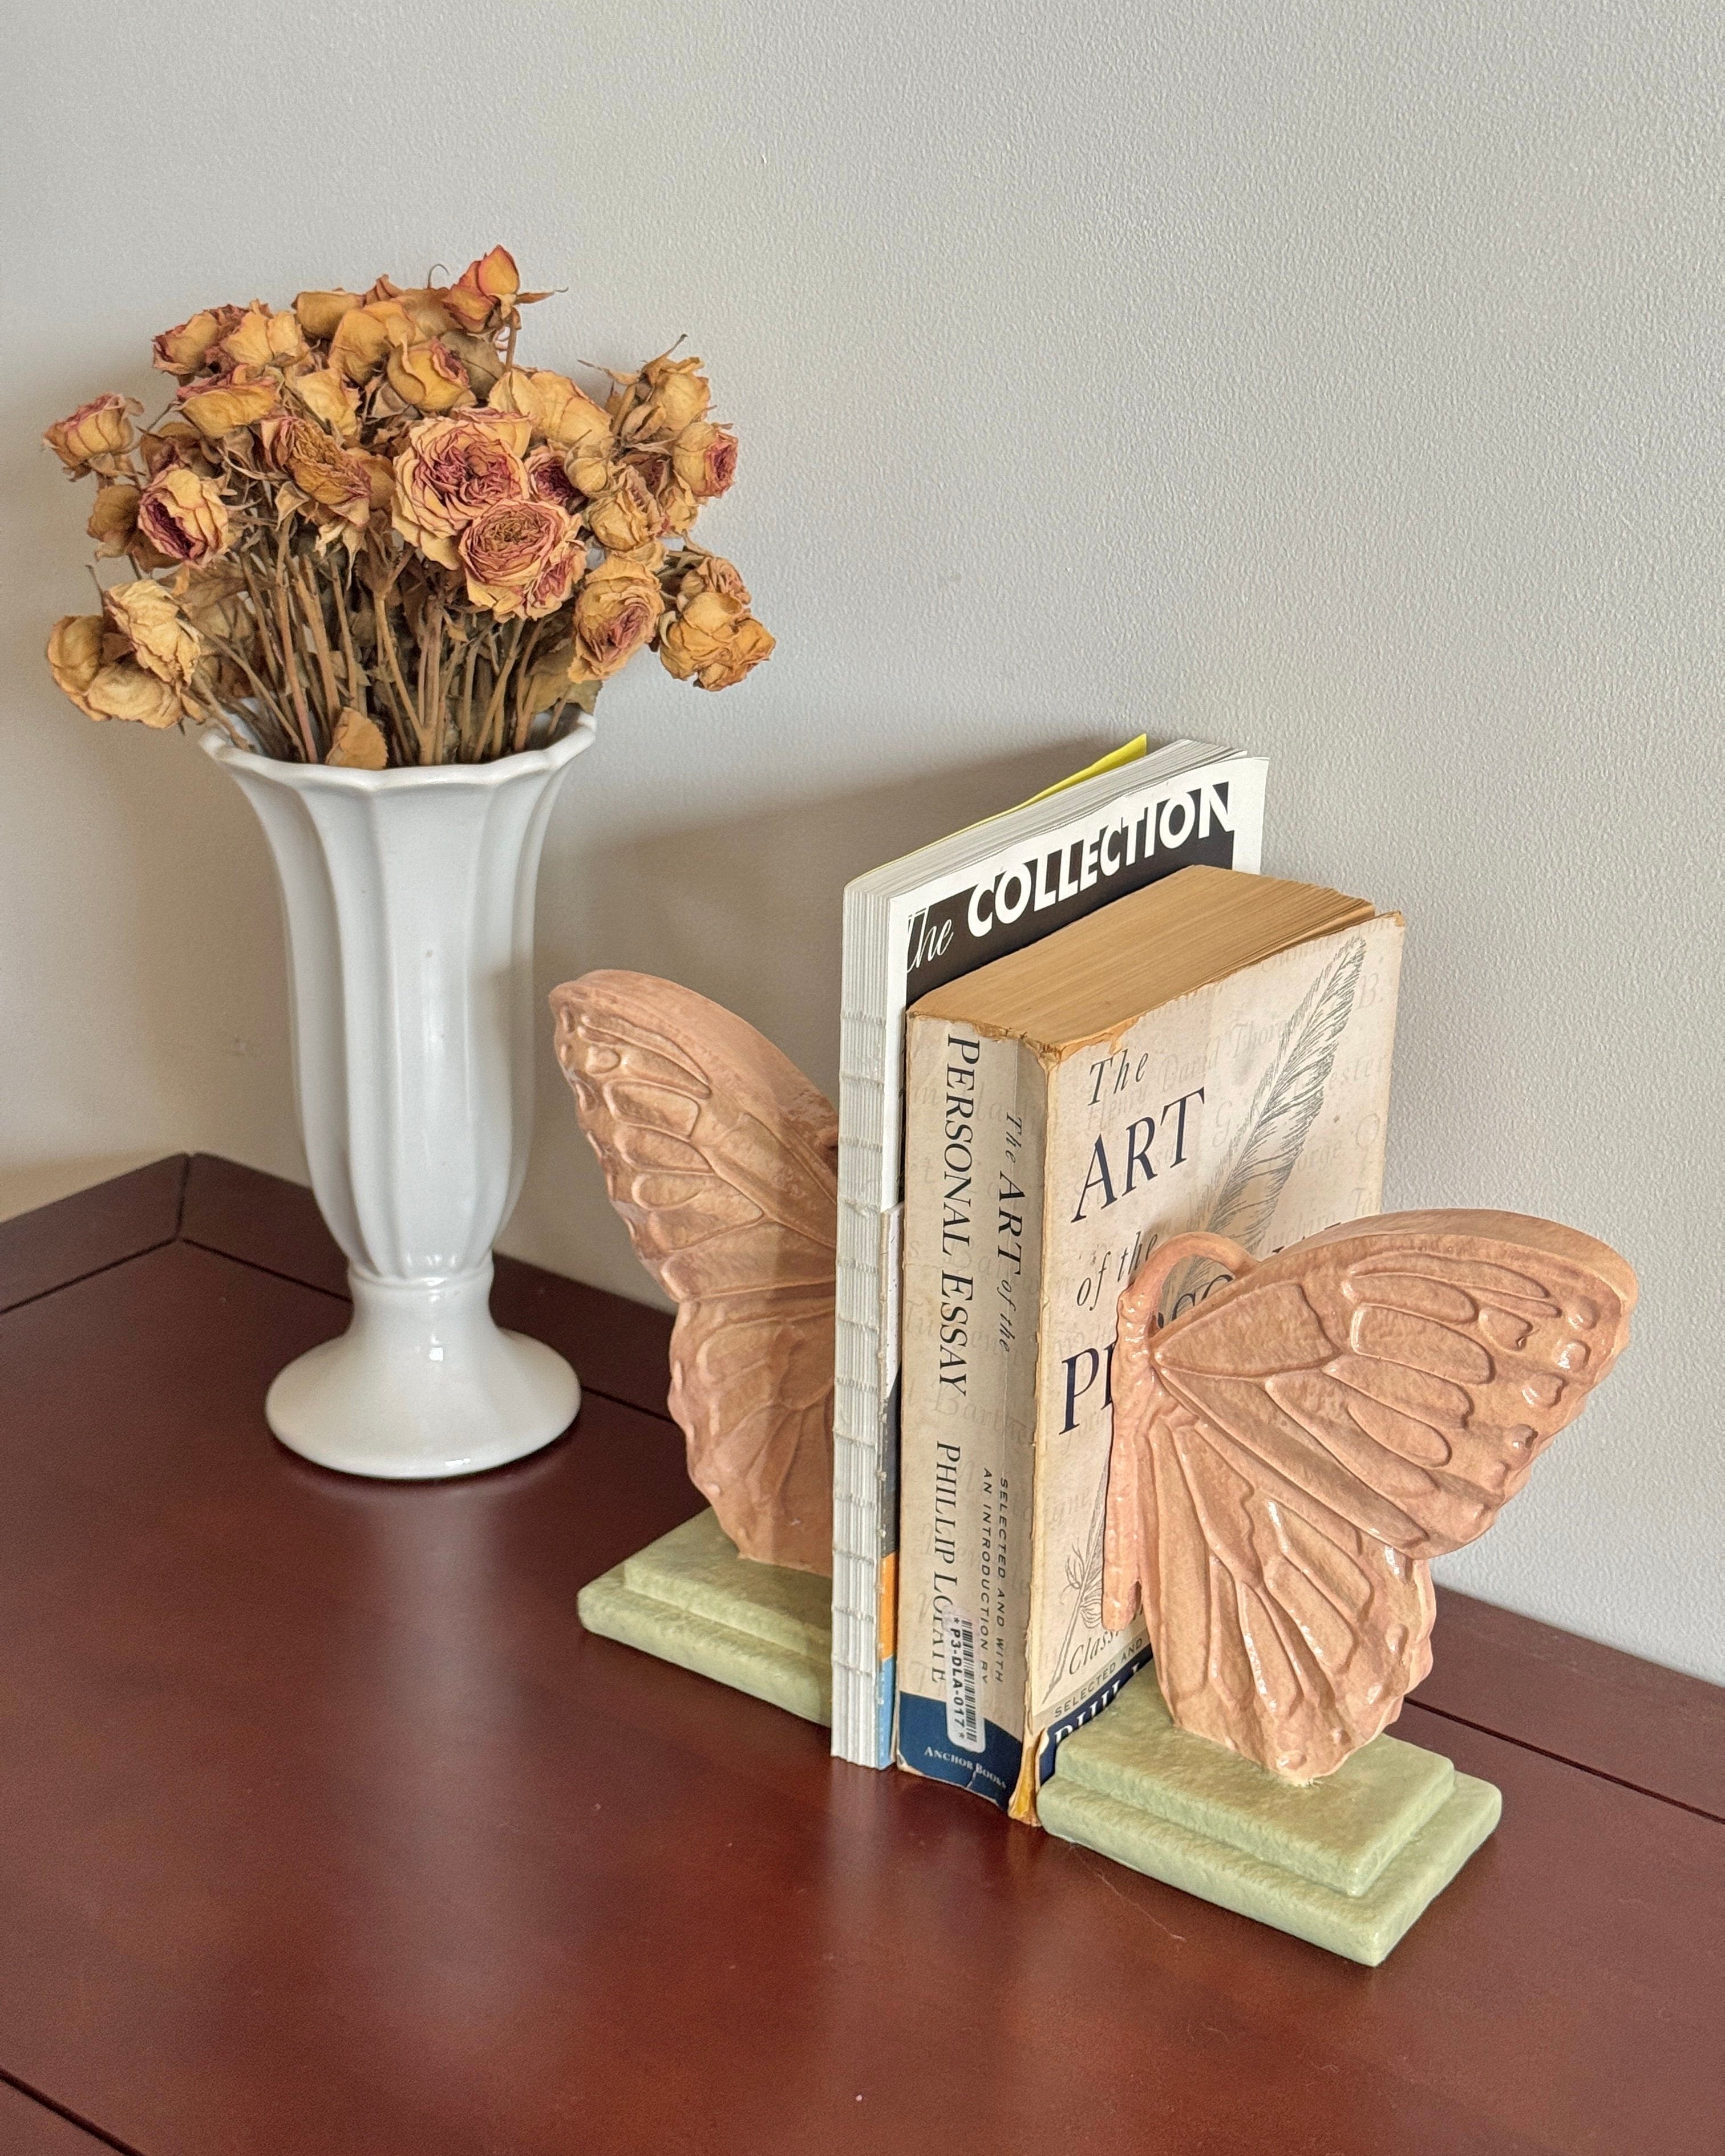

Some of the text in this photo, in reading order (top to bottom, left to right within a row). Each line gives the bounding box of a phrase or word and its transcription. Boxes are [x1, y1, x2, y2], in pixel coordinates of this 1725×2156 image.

[967, 782, 1234, 937] COLLECTION
[1088, 1048, 1148, 1107] The
[939, 1034, 980, 1397] PERSONAL ESSAY
[1071, 1086, 1205, 1223] ART
[997, 1111, 1026, 1353] The ART of the
[1076, 1251, 1111, 1311] of
[1117, 1230, 1159, 1282] the
[934, 1440, 961, 1565] PHILLIP
[983, 1467, 993, 1494] AN
[980, 1503, 992, 1651] INTRODUCTION
[995, 1477, 1009, 1683] SELECTED AND WITH
[1054, 1663, 1116, 1718] SELECTED
[1120, 1638, 1143, 1664] AND
[924, 1746, 973, 1770] ANCHOR
